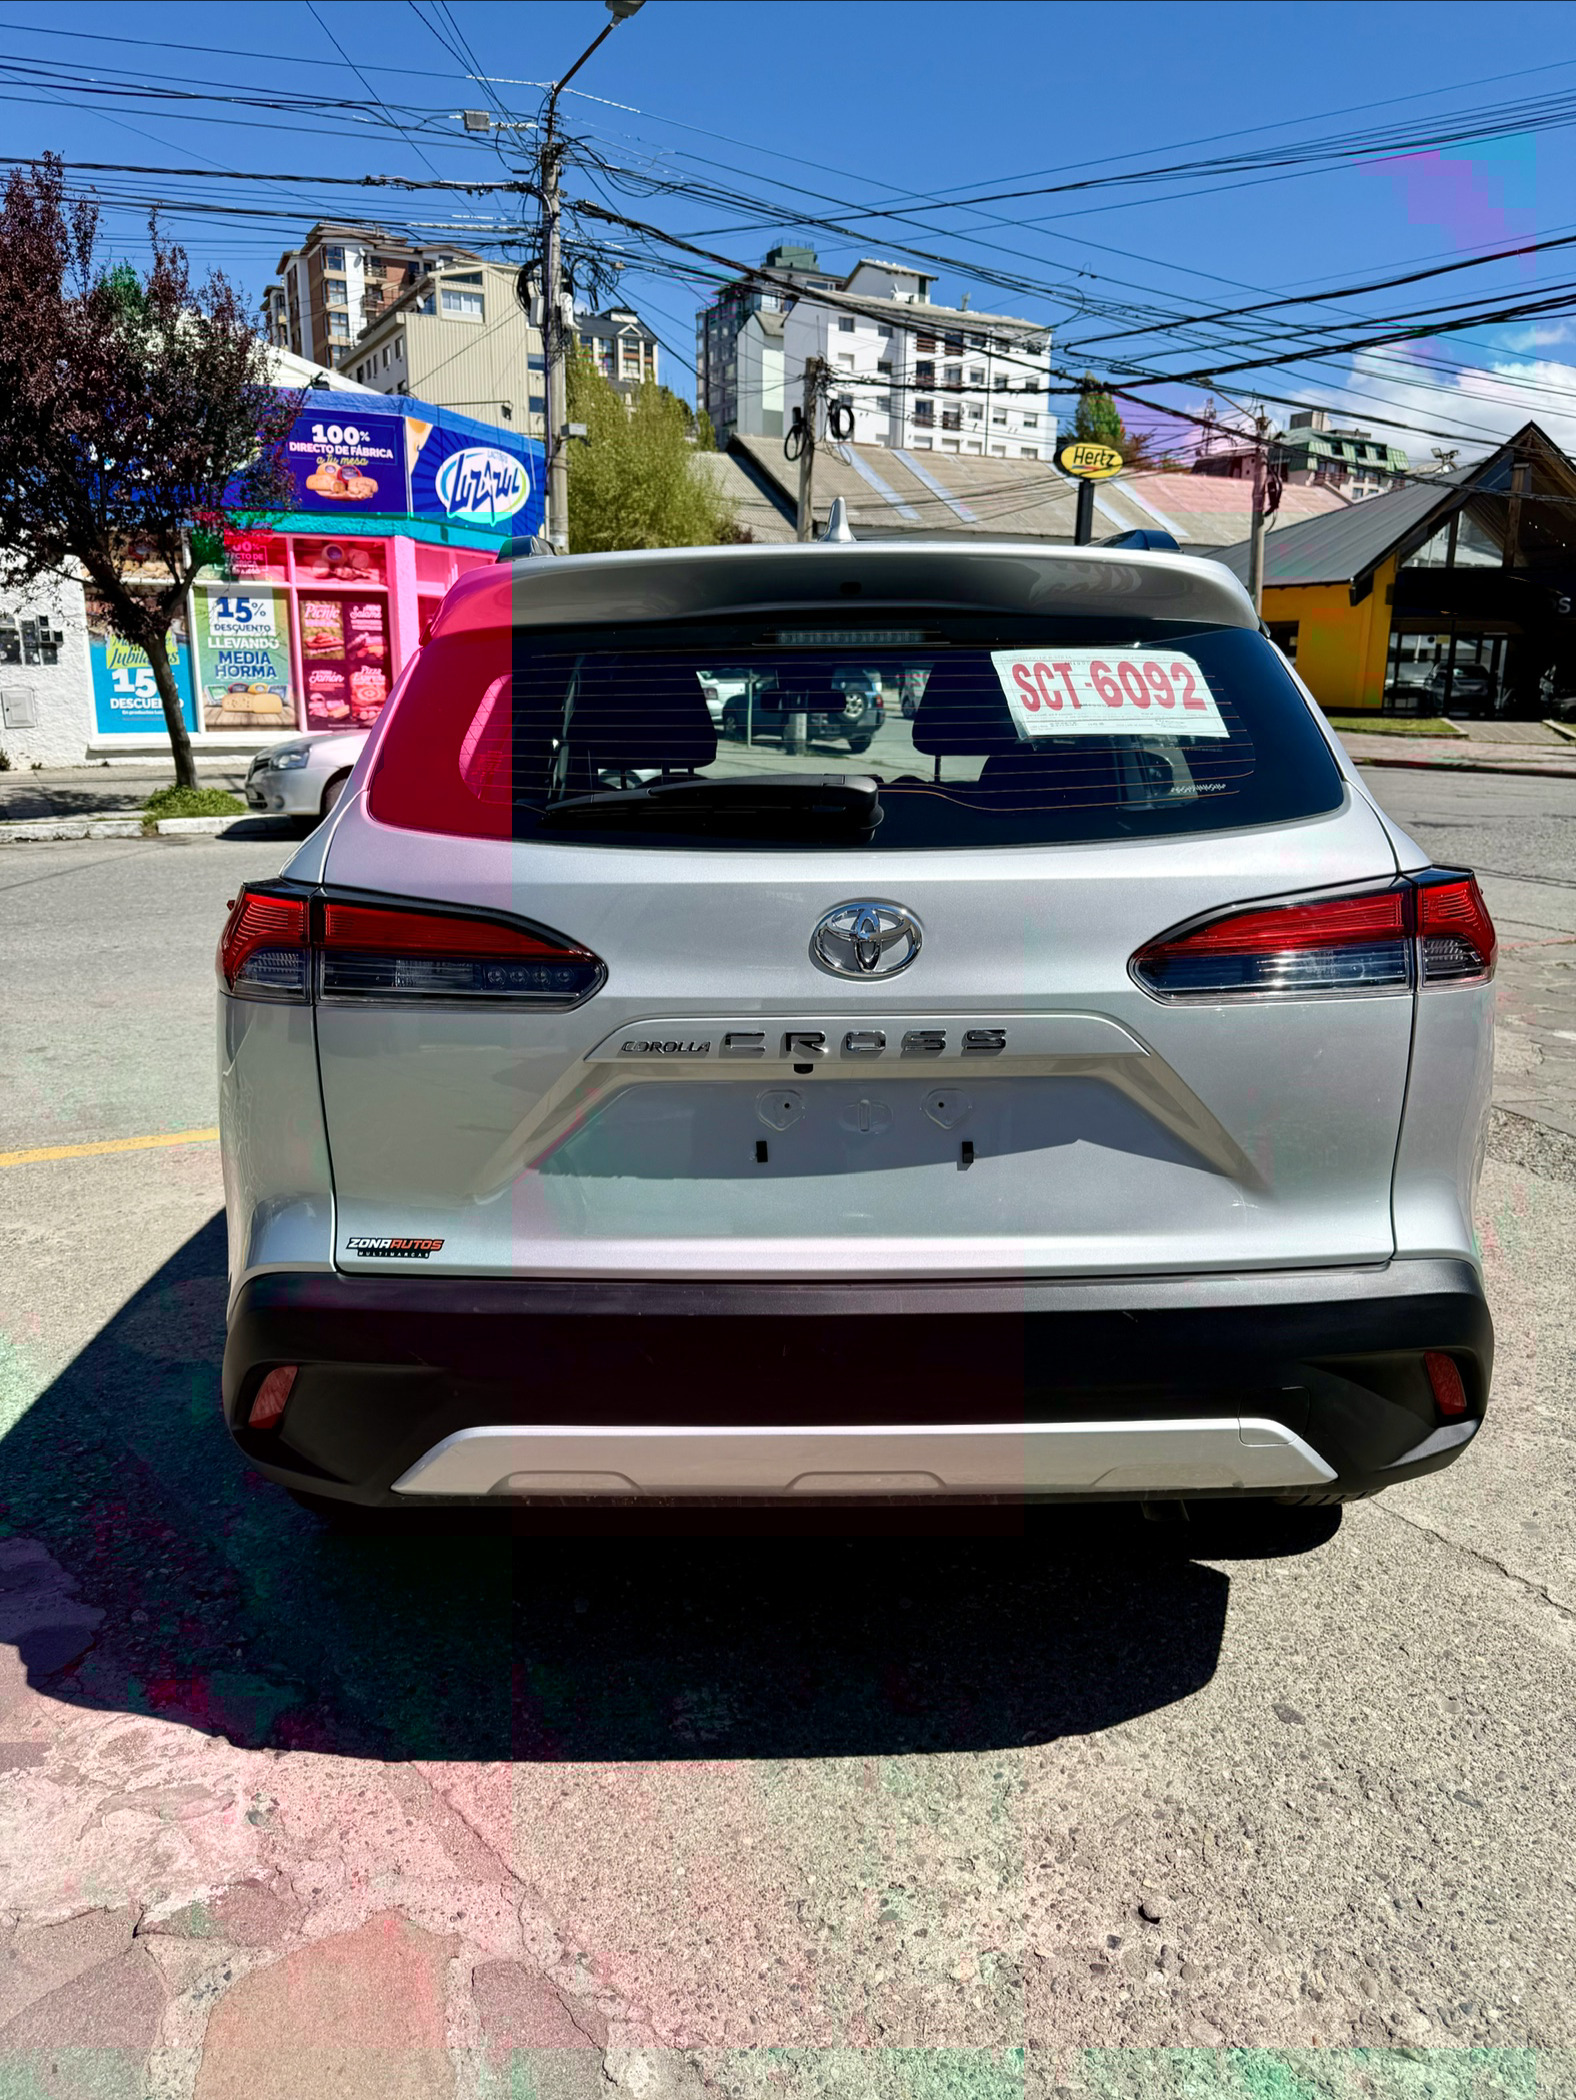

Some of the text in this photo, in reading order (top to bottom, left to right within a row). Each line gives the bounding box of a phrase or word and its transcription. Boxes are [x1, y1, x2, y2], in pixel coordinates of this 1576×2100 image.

[312, 424, 370, 446] 100%
[289, 442, 394, 459] DIRECTO DE FÁBRICA
[1073, 447, 1115, 467] Hertz
[217, 597, 266, 623] 15%
[214, 624, 271, 633] DESCUENTO
[208, 637, 280, 650] LLEVANDO
[219, 652, 271, 664] MEDIA
[216, 666, 277, 677] HORMA
[1012, 661, 1207, 712] SCT-6092
[621, 1028, 1008, 1053] COROLLA CROSS
